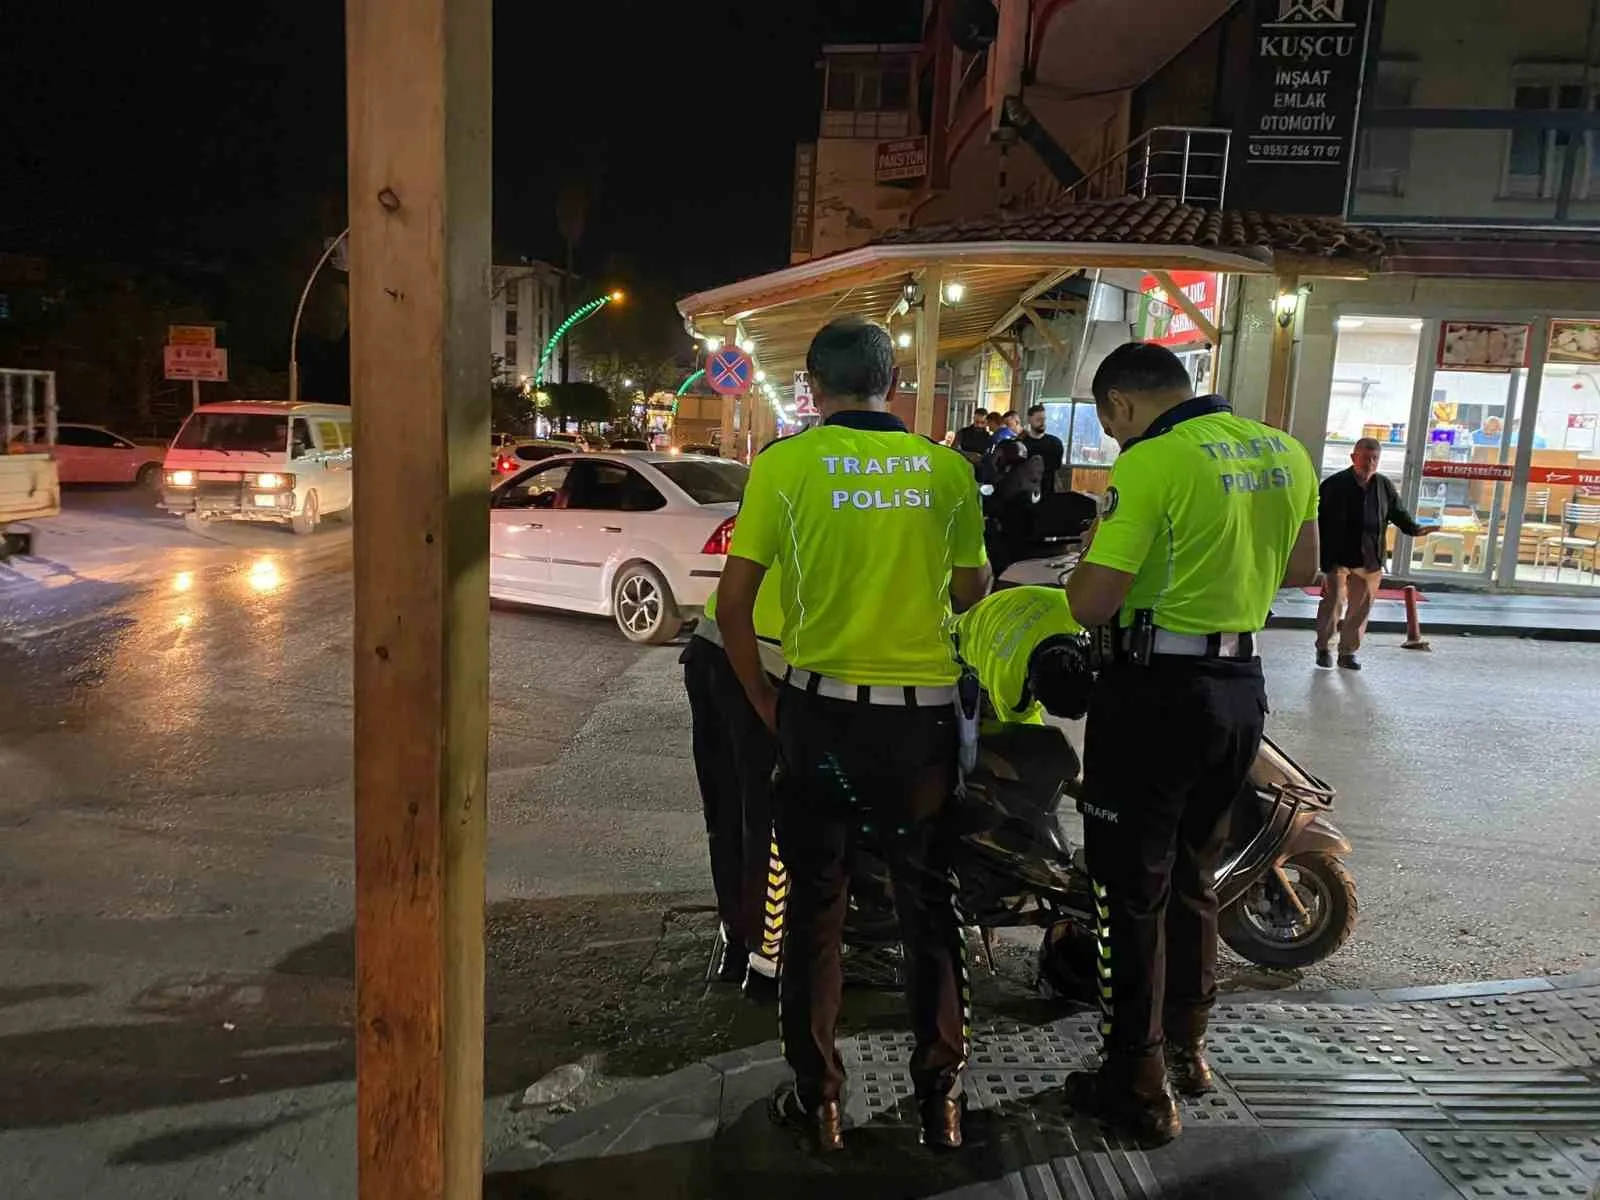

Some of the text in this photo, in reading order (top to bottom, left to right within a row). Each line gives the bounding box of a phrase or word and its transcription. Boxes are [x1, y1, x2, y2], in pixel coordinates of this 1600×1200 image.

[1259, 36, 1353, 61] KUŞCU
[1273, 92, 1327, 109] EMLAK
[1260, 112, 1335, 131] OTOMOTİV
[1313, 145, 1325, 157] 77
